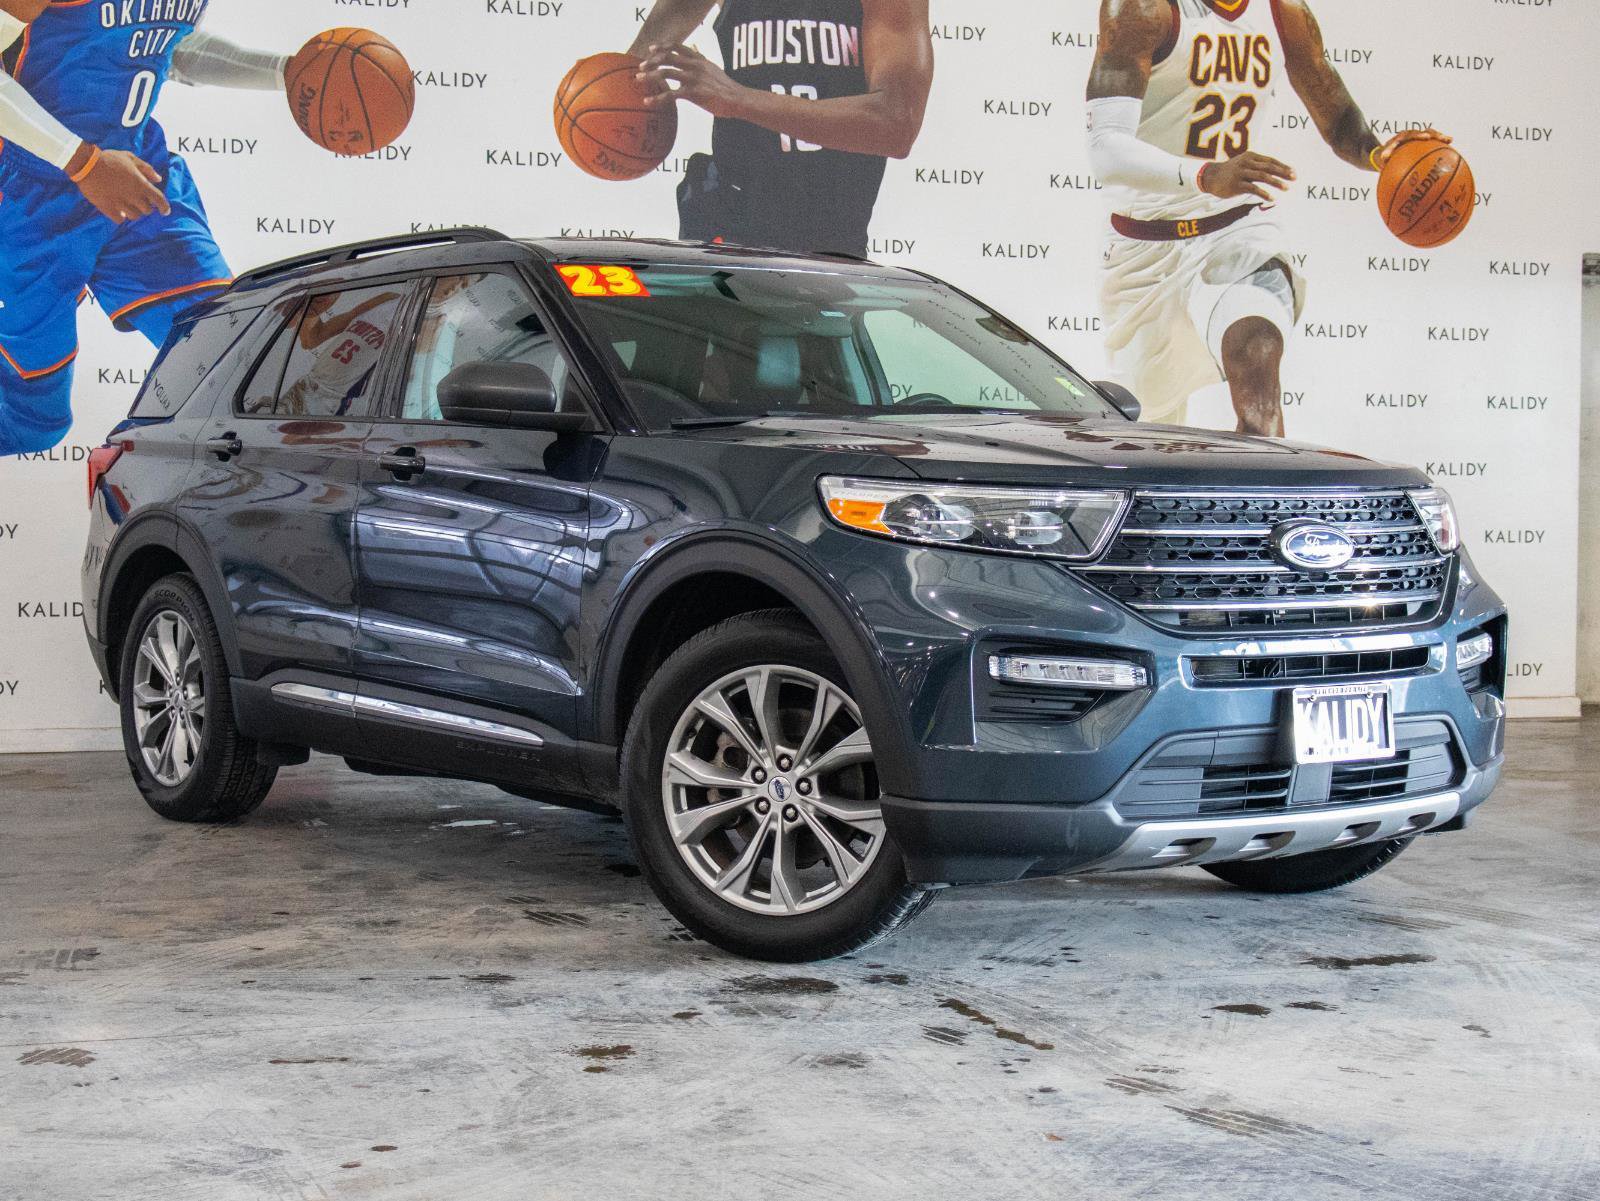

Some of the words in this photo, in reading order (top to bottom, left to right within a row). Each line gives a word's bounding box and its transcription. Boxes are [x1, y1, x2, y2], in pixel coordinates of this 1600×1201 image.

[101, 0, 204, 28] OKLAHOM
[487, 0, 563, 17] KALIDY
[930, 26, 986, 42] ALIDY
[1052, 32, 1100, 48] KALI
[128, 29, 177, 58] CITY
[732, 19, 860, 71] HOUSTON
[1188, 33, 1271, 88] CAVS
[1323, 48, 1372, 63] ALIDY
[1433, 54, 1494, 71] KALIDY
[411, 70, 487, 88] KALIDY
[121, 70, 156, 128] 0
[984, 100, 1052, 117] KALIDY
[1184, 92, 1257, 160] 23
[1492, 126, 1552, 141] KALIDY
[178, 137, 257, 155] KALIDY
[487, 150, 562, 167] KALIDY
[915, 169, 984, 185] KALIDY
[1307, 186, 1370, 201] KALIDY
[257, 217, 335, 234] KALIDY
[1177, 218, 1199, 237] CLE
[867, 240, 915, 254] LIDY
[982, 243, 1049, 259] KALIDY
[1368, 257, 1430, 272] KALIDY
[1490, 261, 1550, 276] KALIDY
[559, 265, 641, 295] 23
[1048, 316, 1101, 331] KALID
[1305, 324, 1368, 338] KALIDY
[1428, 327, 1489, 341] KALIDY
[1366, 394, 1427, 408] KALIDY
[1488, 396, 1547, 410] KALIDY
[1426, 462, 1487, 476] KALIDY
[1485, 530, 1545, 543] KALIDY
[18, 602, 84, 617] KALID
[1295, 697, 1385, 752] KALIDY
